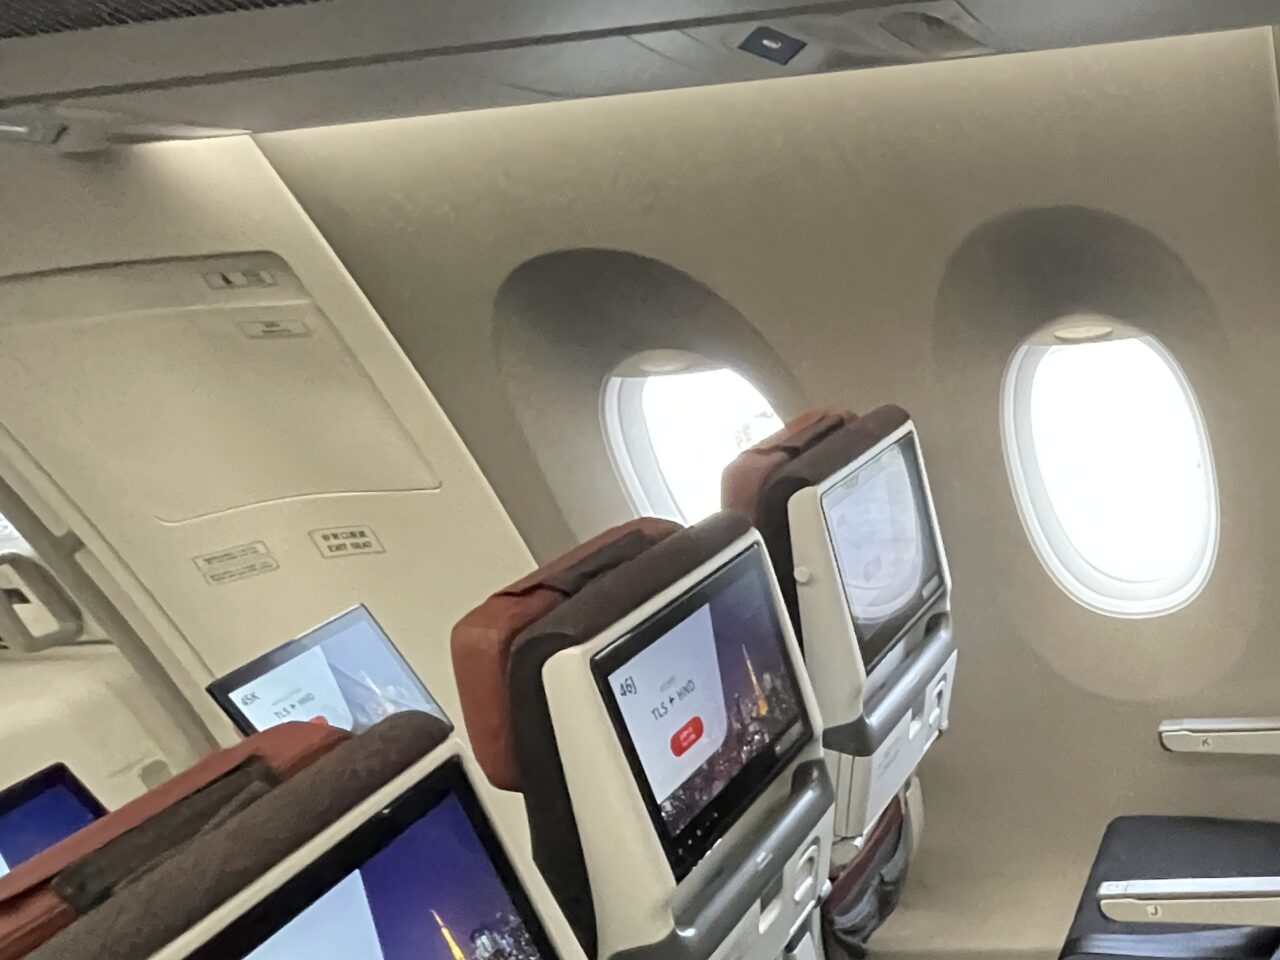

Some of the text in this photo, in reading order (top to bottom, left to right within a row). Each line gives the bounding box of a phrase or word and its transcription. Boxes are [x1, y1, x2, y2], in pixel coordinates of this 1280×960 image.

[620, 676, 637, 696] 46J
[651, 701, 668, 720] TLS
[676, 679, 695, 701] HND
[1201, 737, 1211, 747] K
[1150, 905, 1158, 916] J
